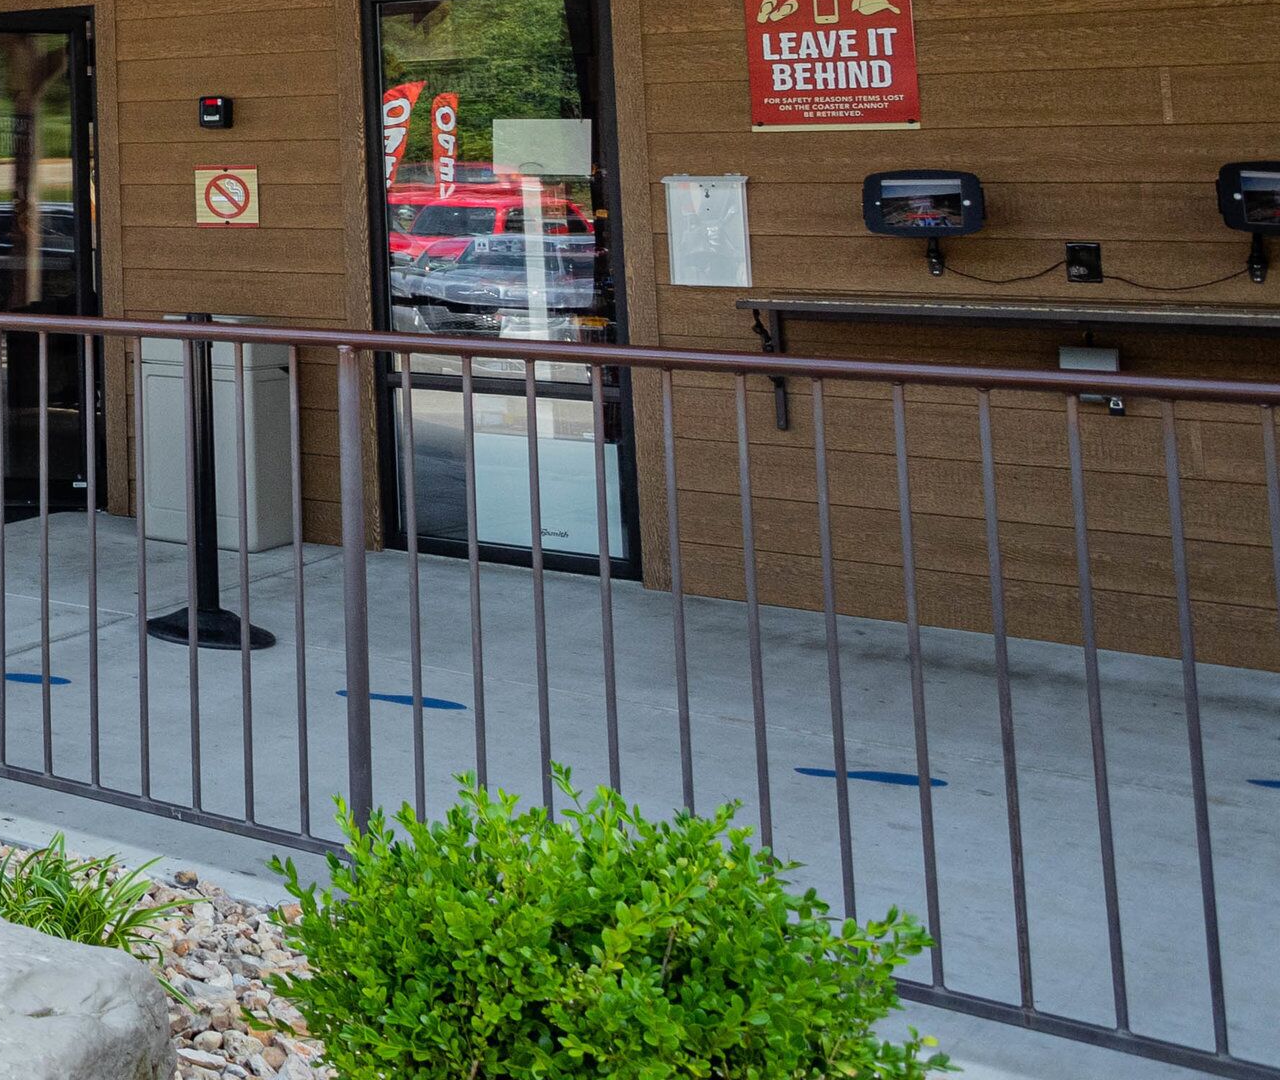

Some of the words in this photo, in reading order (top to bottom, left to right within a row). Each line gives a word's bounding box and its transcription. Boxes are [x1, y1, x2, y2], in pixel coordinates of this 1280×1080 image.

[762, 29, 858, 60] LEAVE
[867, 27, 897, 56] IT
[771, 59, 893, 91] BEHIND
[782, 96, 811, 104] SAFETY
[814, 95, 853, 103] REASONS
